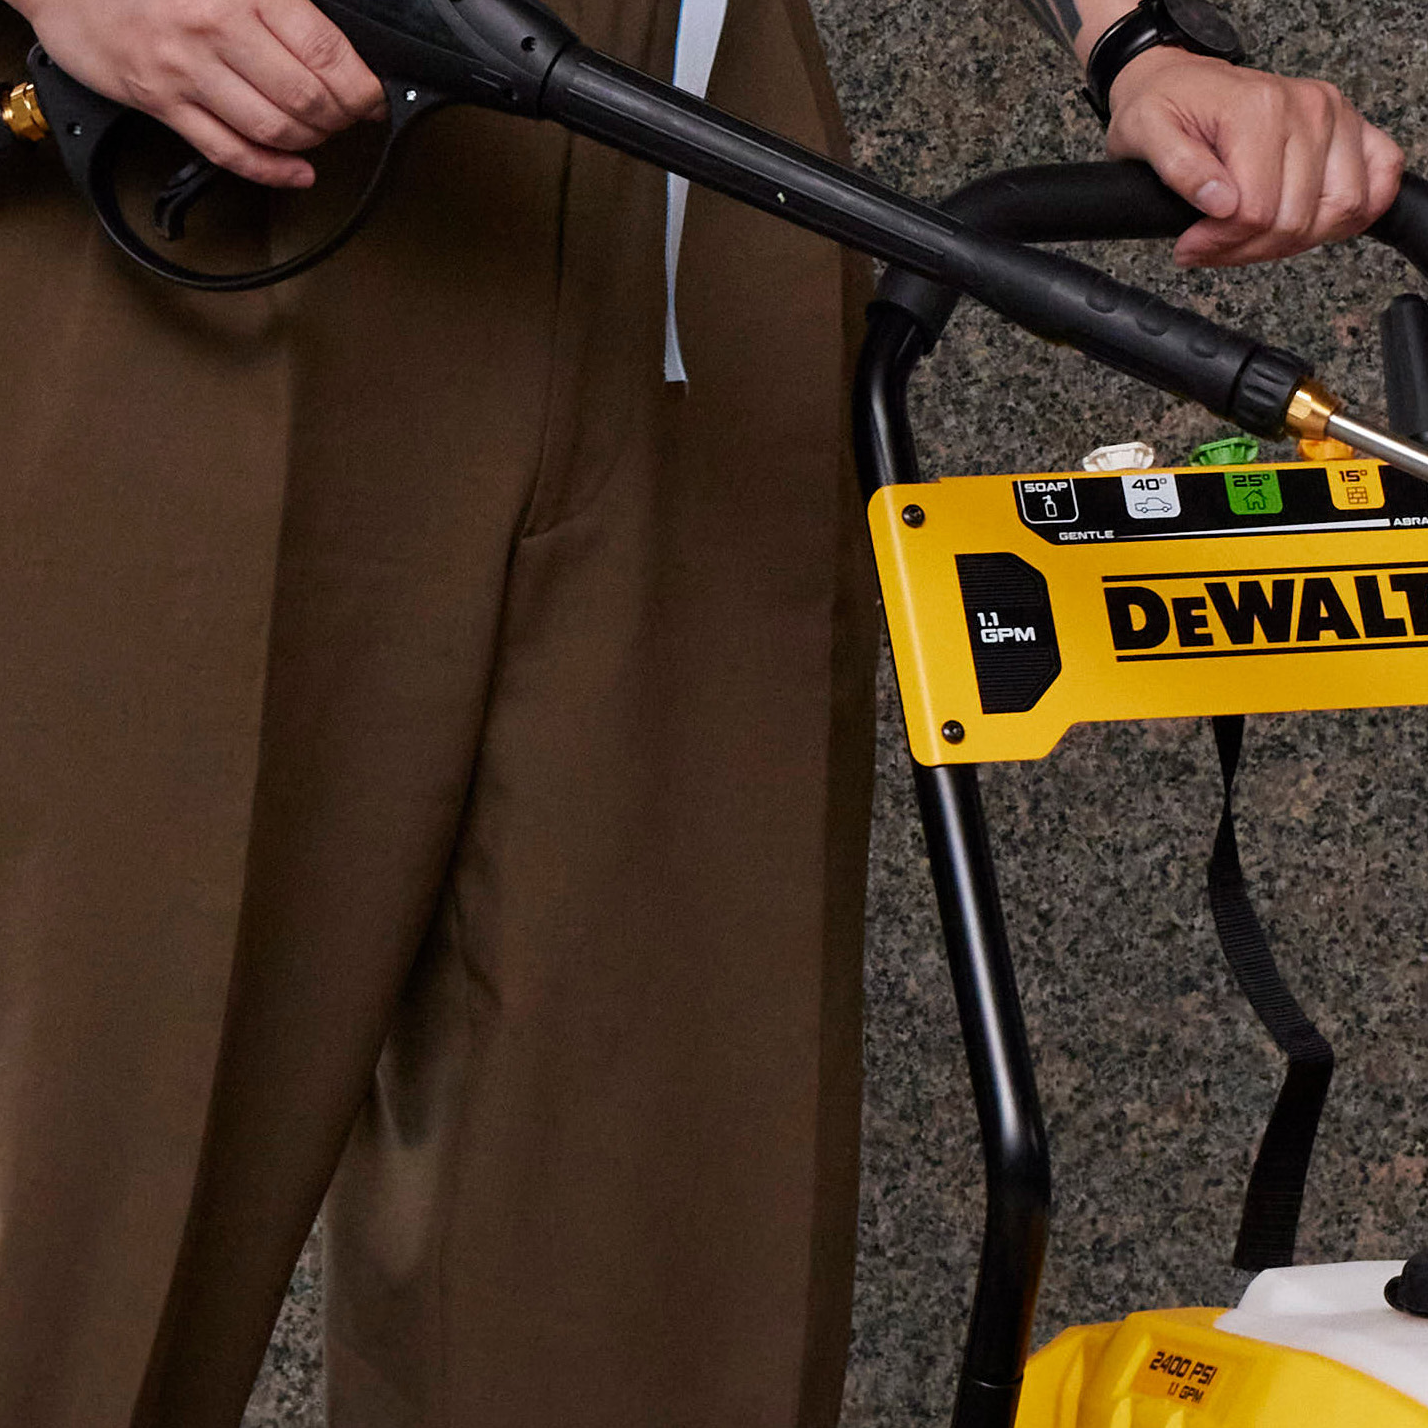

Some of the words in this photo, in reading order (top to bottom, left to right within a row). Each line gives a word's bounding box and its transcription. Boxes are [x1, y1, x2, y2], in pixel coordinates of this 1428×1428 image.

[1232, 474, 1270, 488] 25°
[1339, 469, 1368, 483] 15°
[1024, 481, 1069, 493] SOAP
[1132, 477, 1167, 491] 40°
[1058, 530, 1115, 541] GENTLE
[977, 611, 999, 627] 1.1
[980, 626, 1036, 644] GPM
[1149, 1350, 1192, 1378] 2400
[1187, 1361, 1218, 1386] PSI
[1178, 1385, 1205, 1404] GPM
